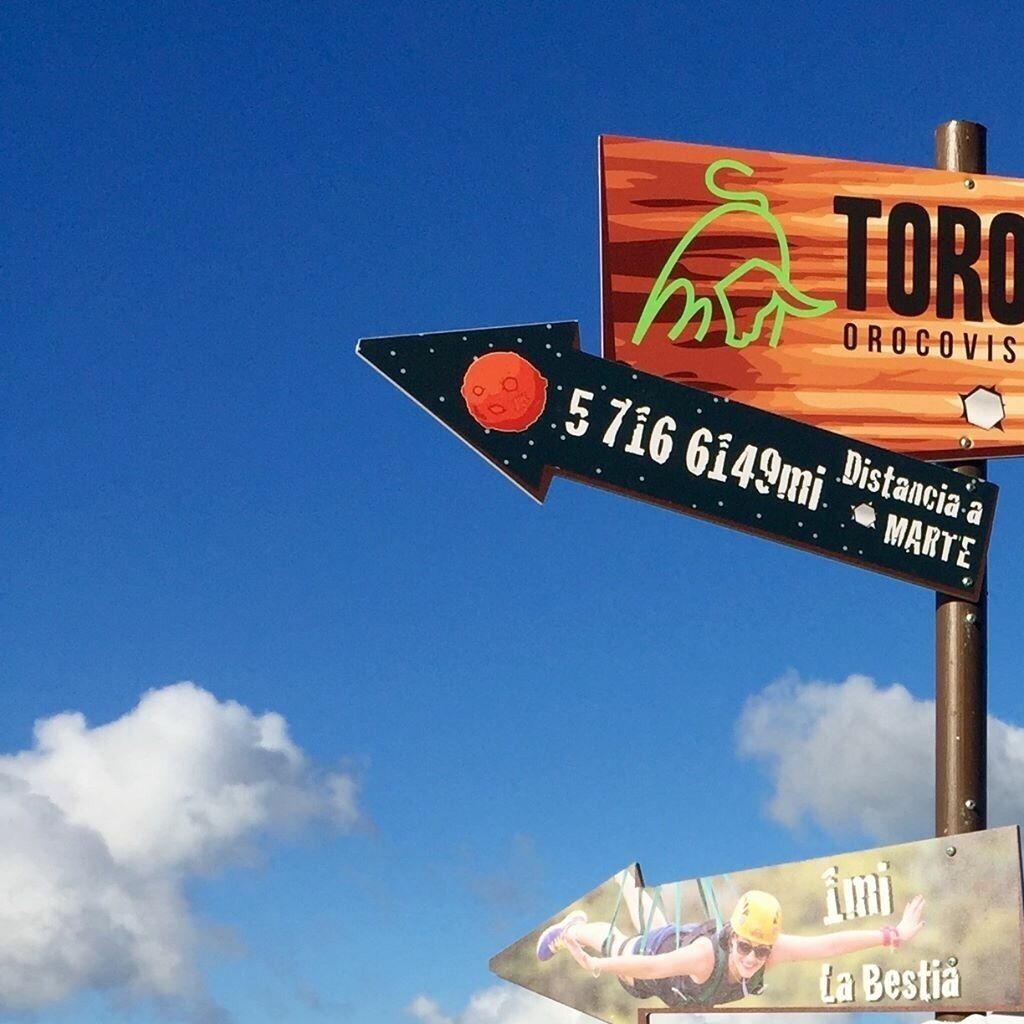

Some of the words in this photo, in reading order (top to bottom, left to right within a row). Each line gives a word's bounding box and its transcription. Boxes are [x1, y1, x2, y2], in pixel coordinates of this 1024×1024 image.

[565, 388, 594, 437] 5
[602, 398, 677, 465] 716
[842, 449, 961, 518] Distancia
[966, 500, 983, 526] a
[883, 513, 976, 569] MARTE
[819, 963, 855, 1004] La
[862, 959, 961, 1003] Bestia
